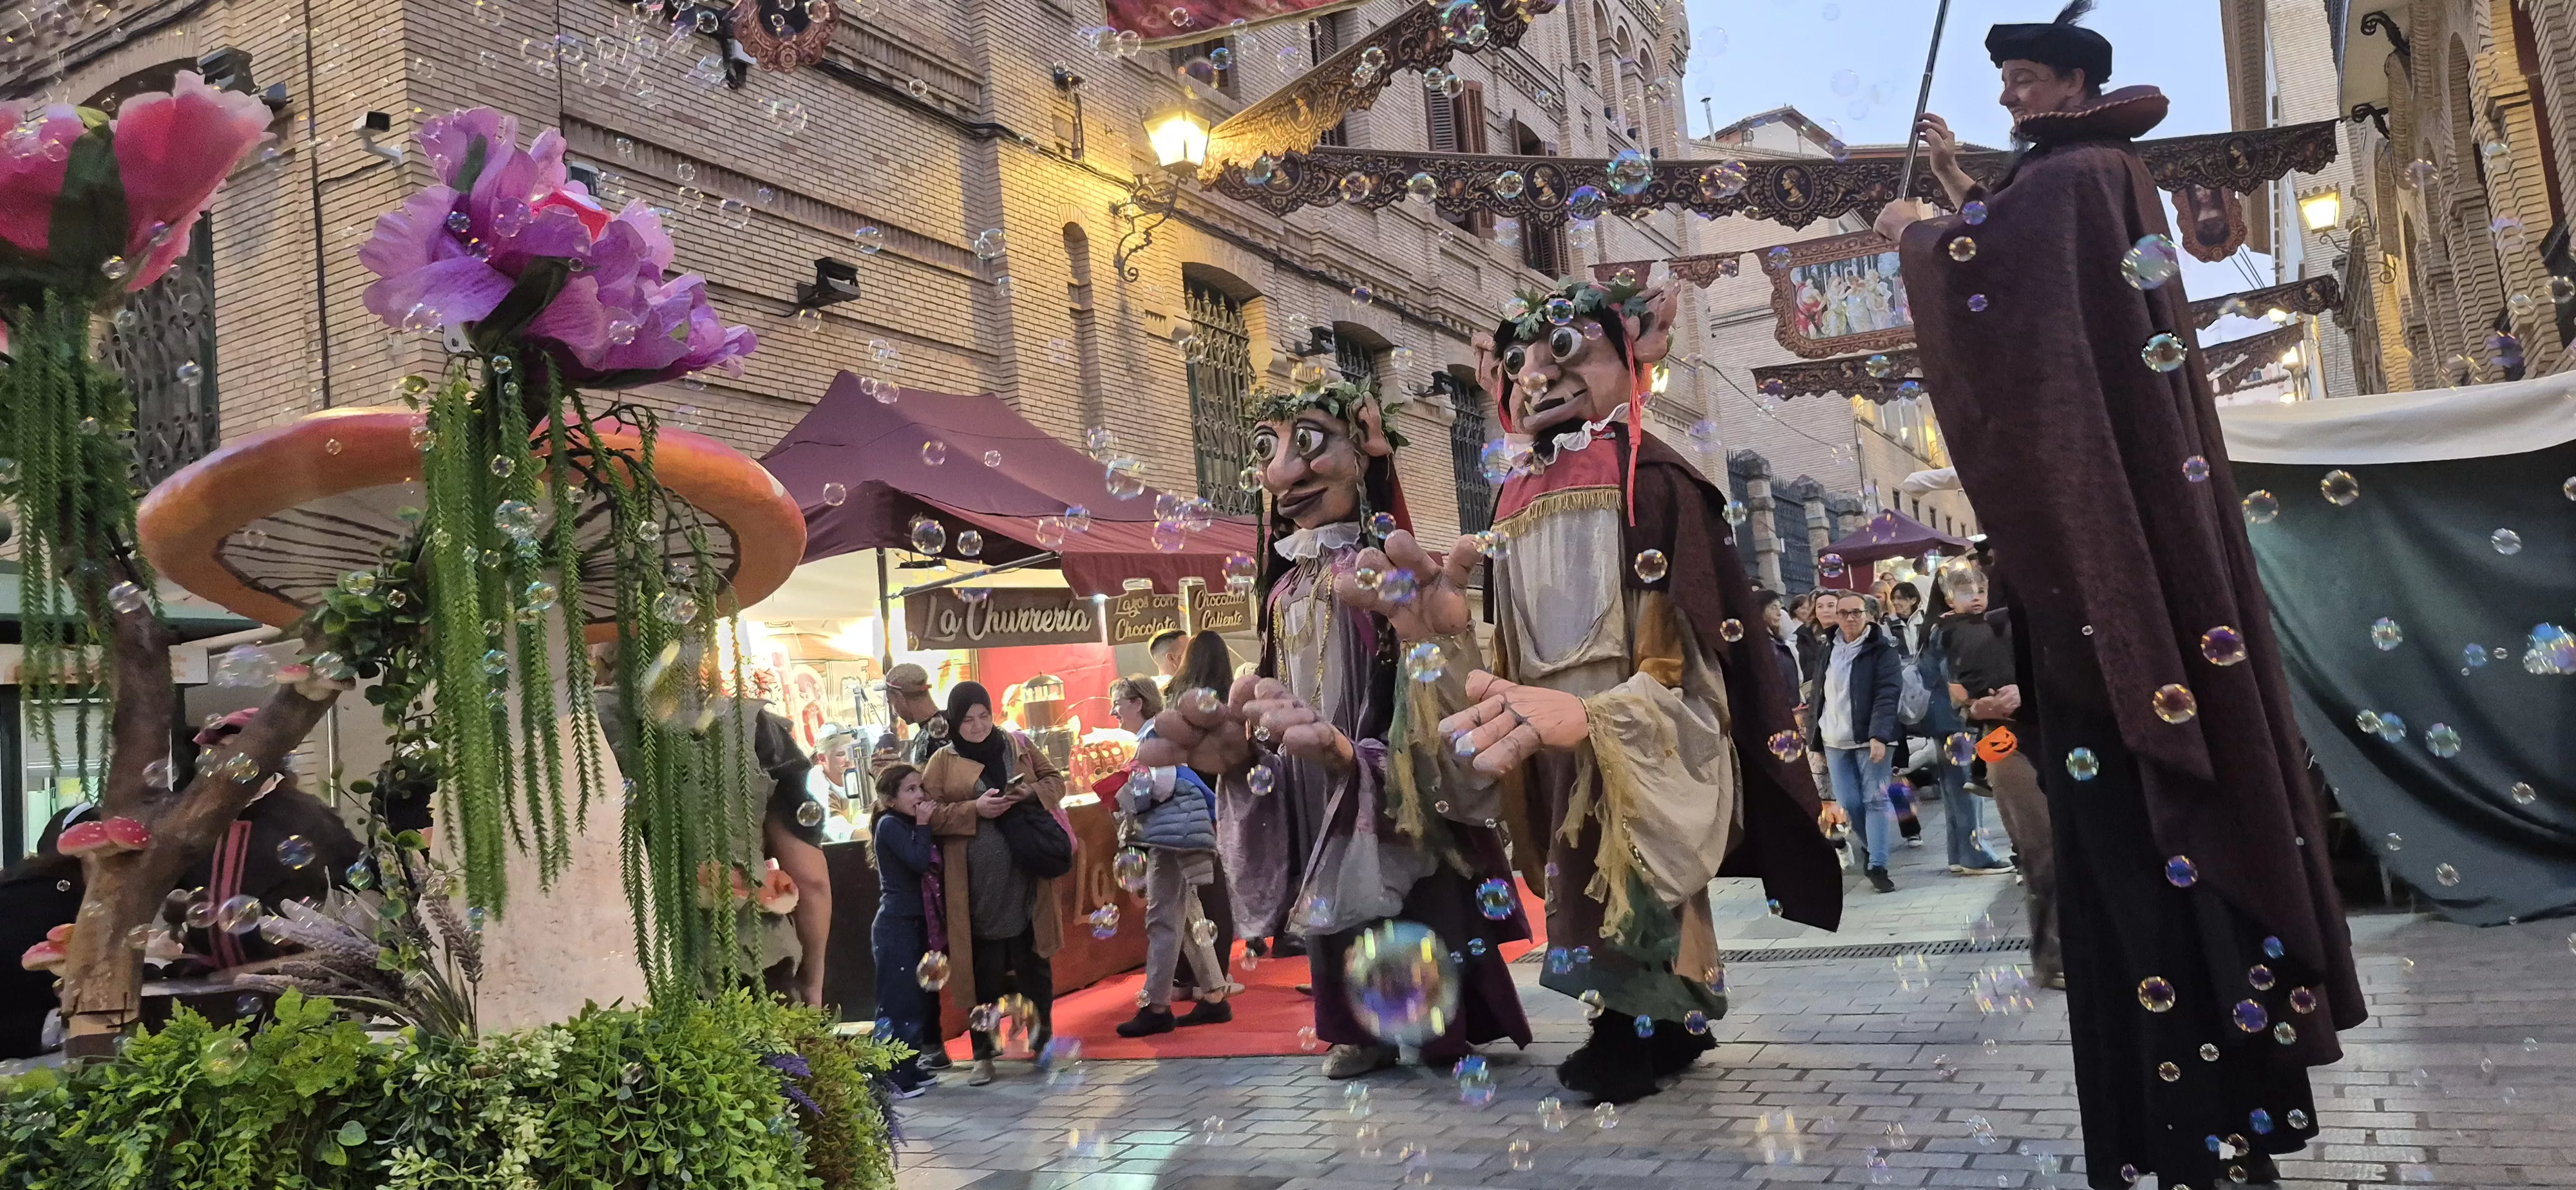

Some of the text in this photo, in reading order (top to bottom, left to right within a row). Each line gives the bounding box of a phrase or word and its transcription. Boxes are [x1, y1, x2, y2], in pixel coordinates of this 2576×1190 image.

[923, 594, 1092, 642] La Churrería
[1115, 596, 1177, 618] Lazos con
[1115, 616, 1177, 641] Chocolate
[1201, 610, 1244, 630] Caliente
